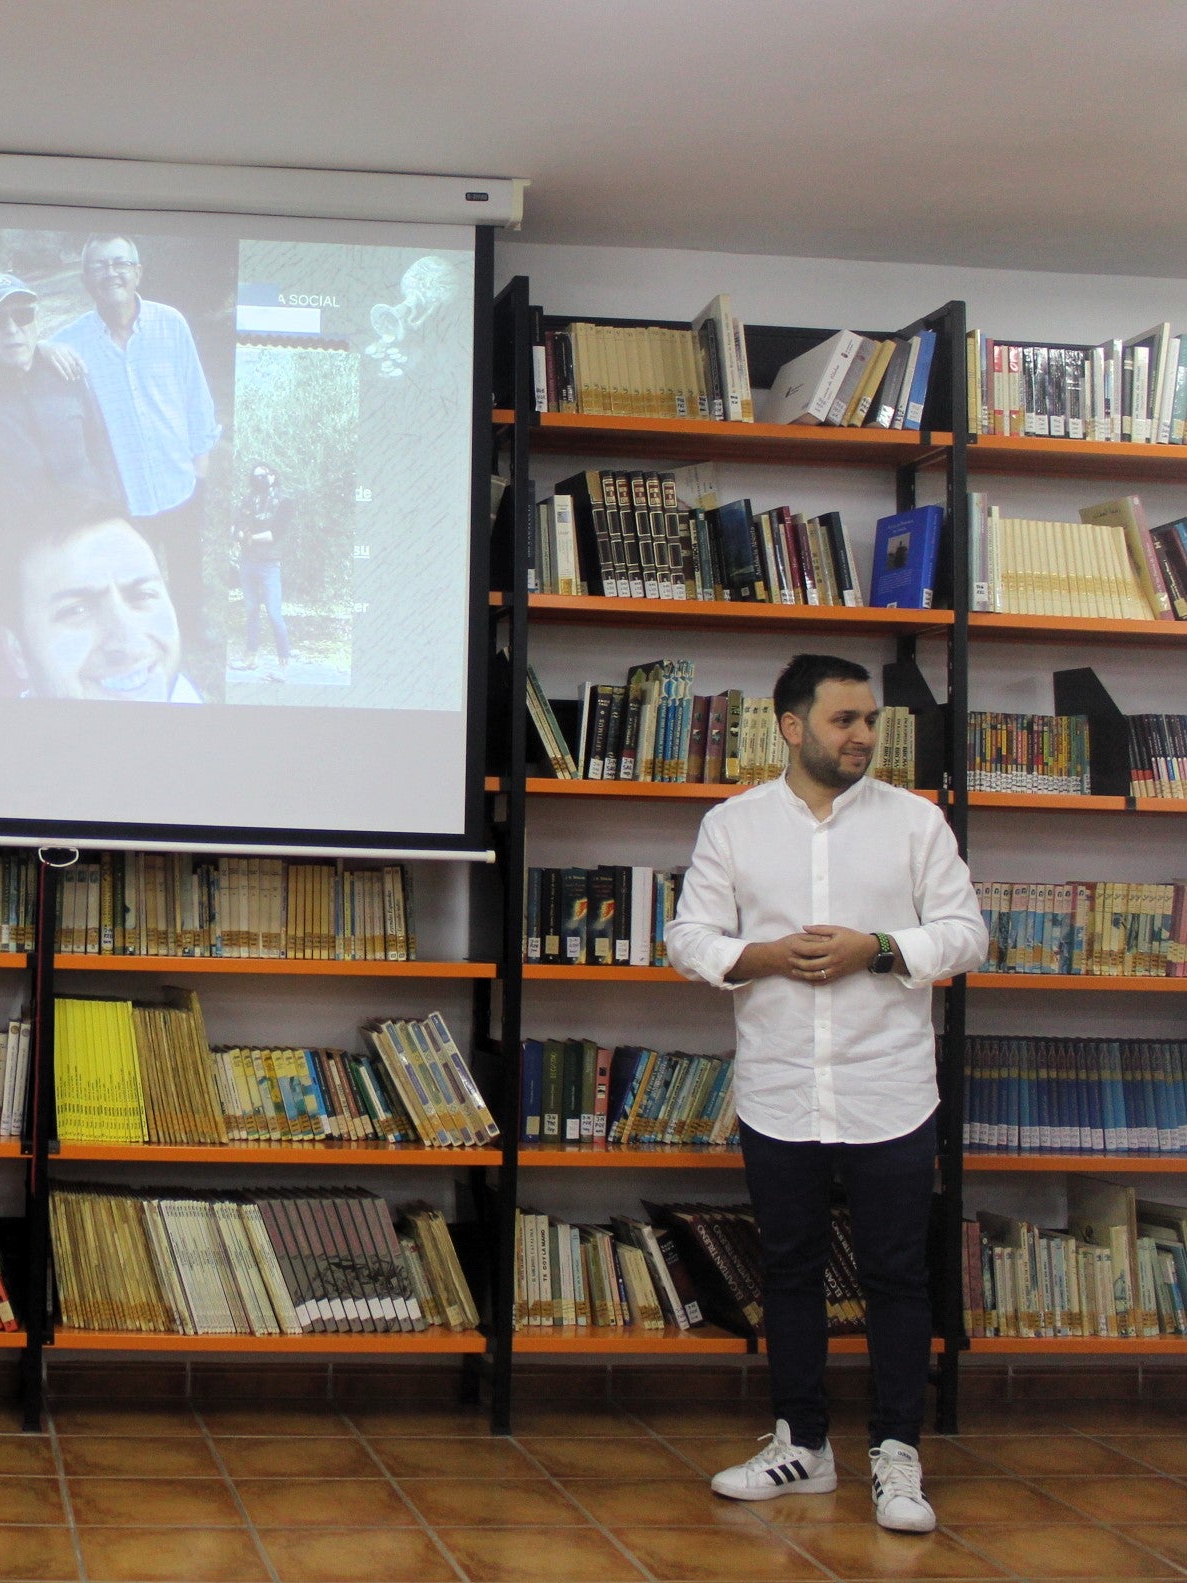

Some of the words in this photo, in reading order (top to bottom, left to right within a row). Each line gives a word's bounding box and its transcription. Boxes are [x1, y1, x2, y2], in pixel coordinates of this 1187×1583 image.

[289, 294, 340, 308] SOCIAL
[354, 544, 370, 557] su
[595, 718, 604, 751] SEPTIMUS
[697, 1224, 718, 1256] TRUENO
[715, 1255, 739, 1292] CAPITAN
[735, 1289, 744, 1301] EL
